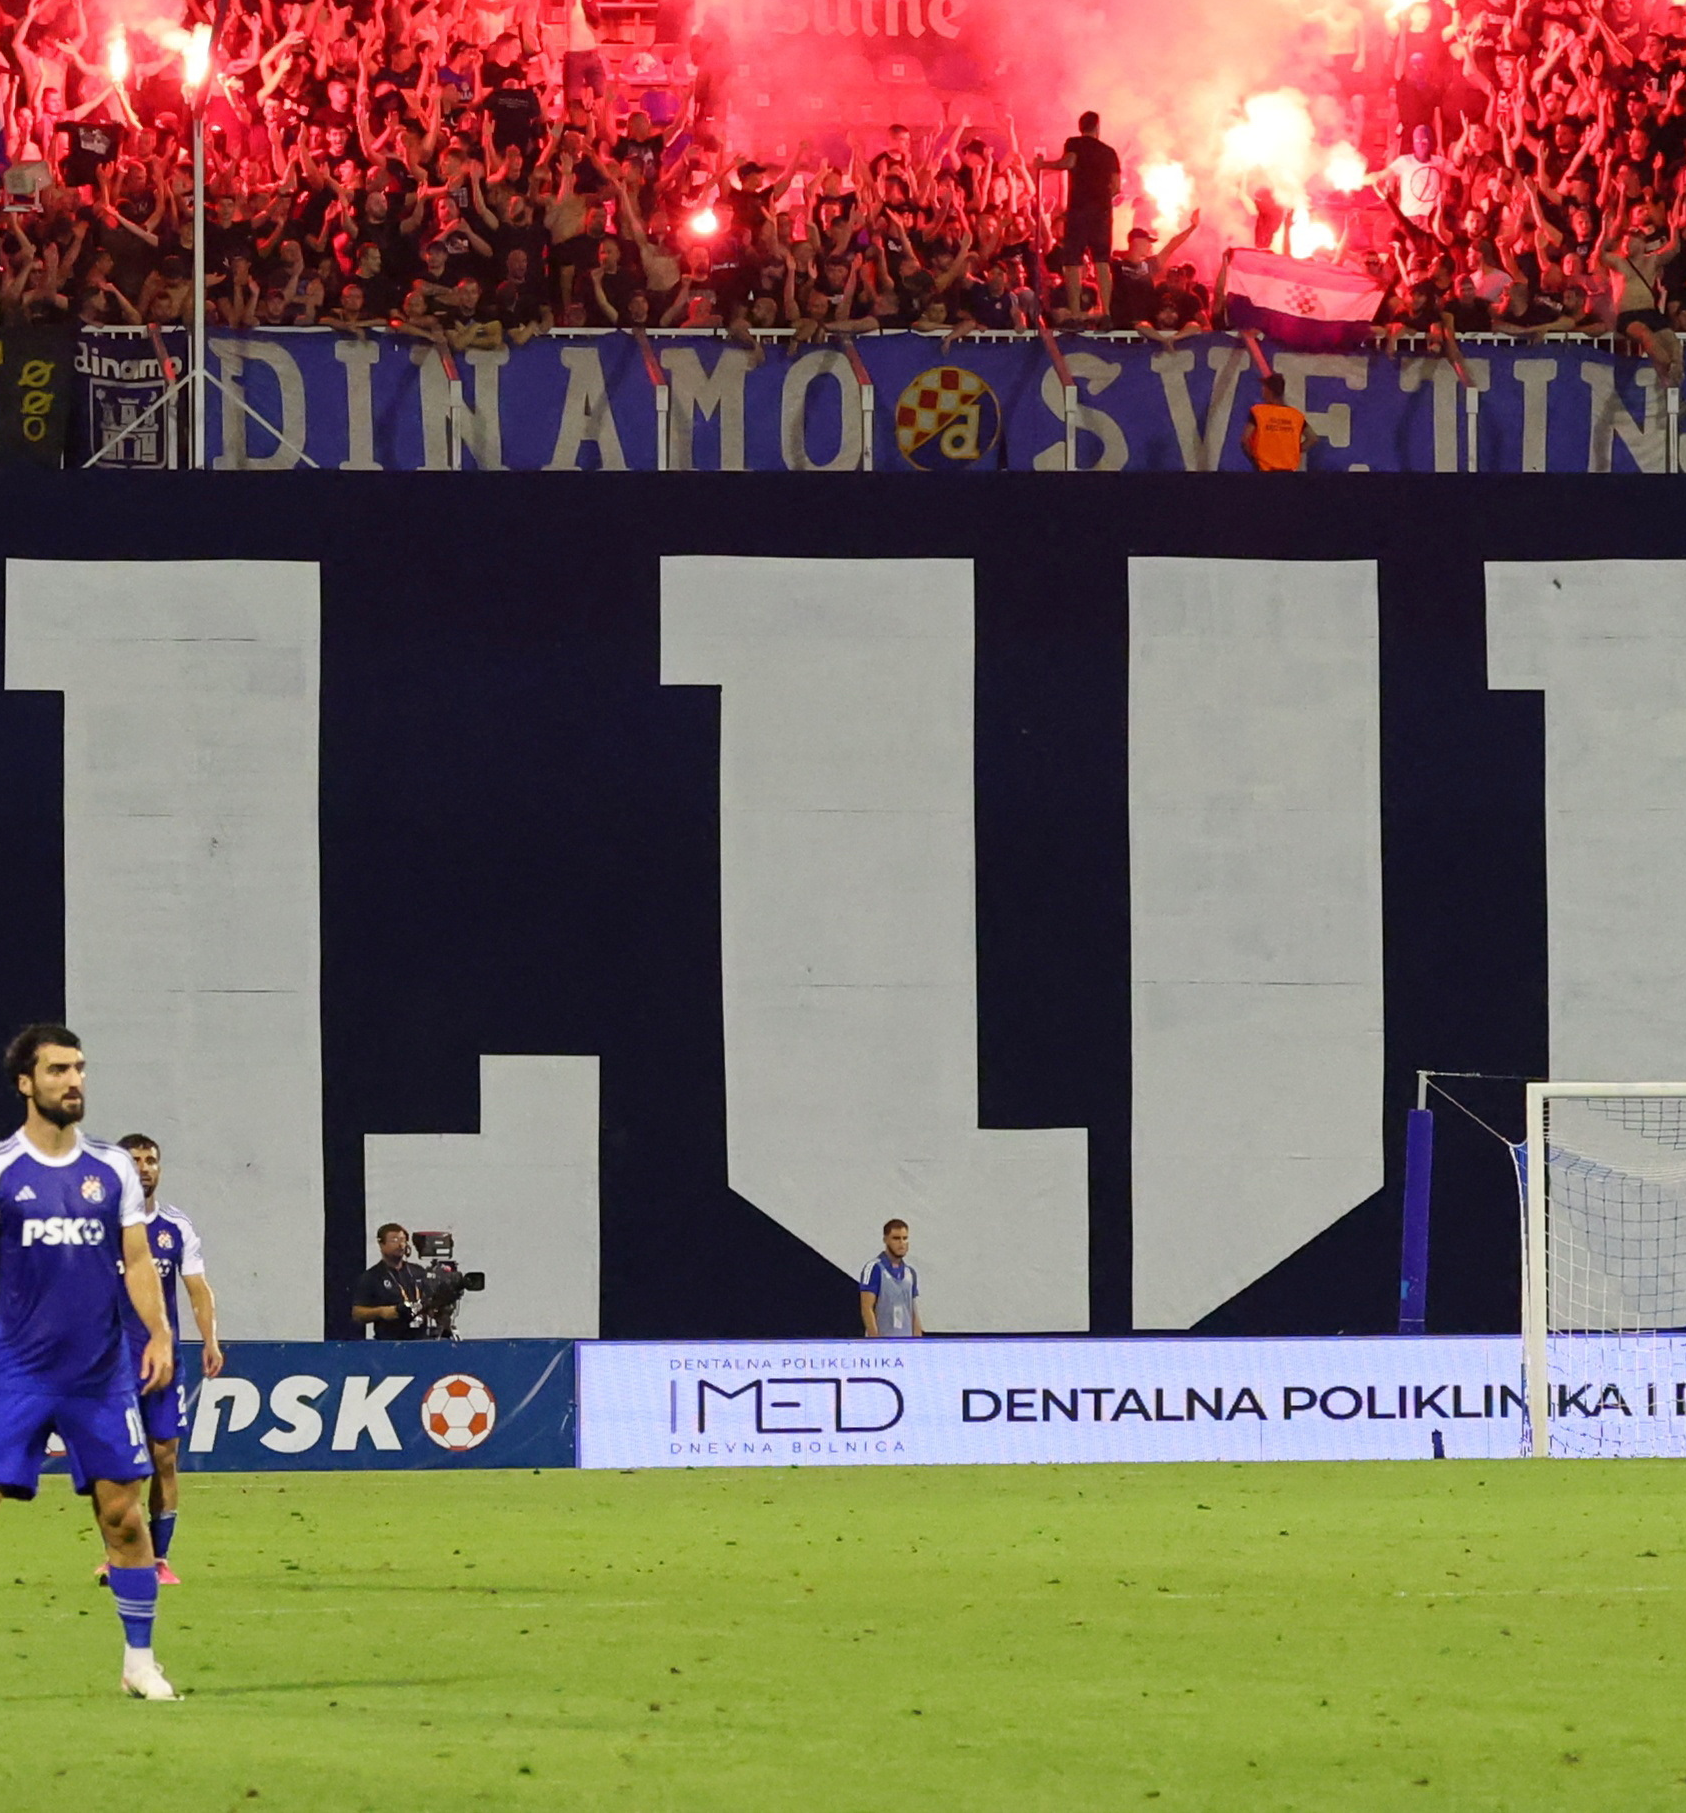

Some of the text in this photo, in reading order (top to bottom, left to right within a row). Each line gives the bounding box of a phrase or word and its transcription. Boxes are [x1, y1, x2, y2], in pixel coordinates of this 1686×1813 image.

[206, 337, 870, 473] DINAMO
[21, 1218, 85, 1247] PSK
[669, 1357, 905, 1371] DENTALNA POLIKLINIKA
[187, 1374, 415, 1453] PSK
[962, 1387, 1267, 1424] DENTALNA
[669, 1441, 906, 1455] DNEVNA BOLNICA
